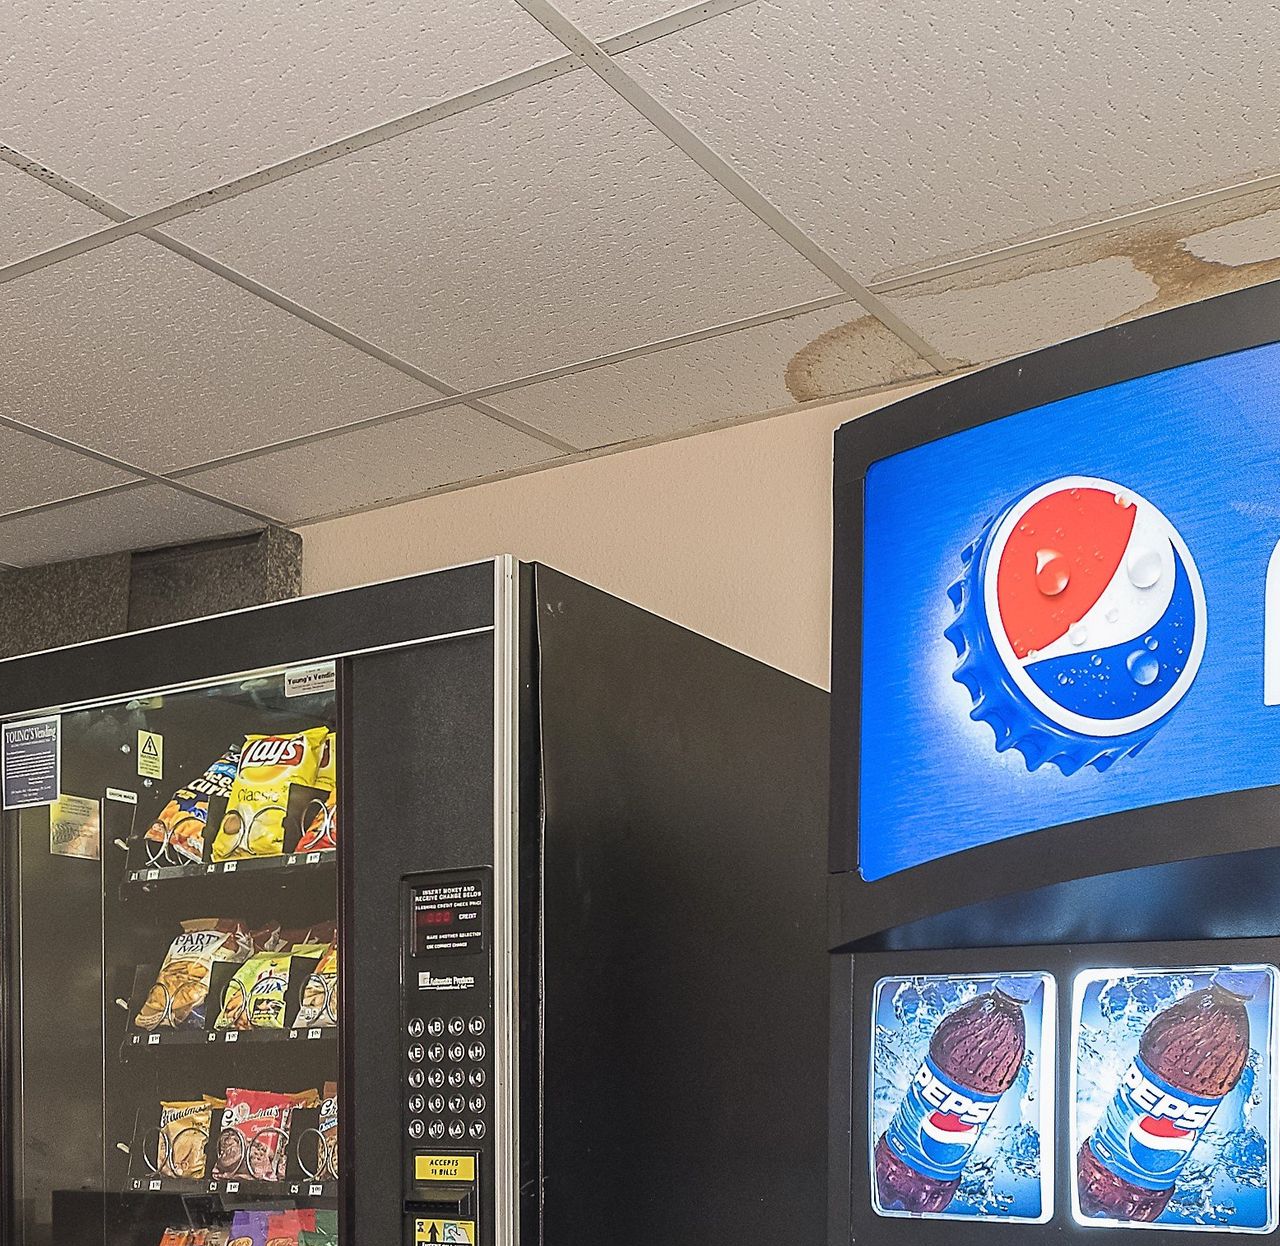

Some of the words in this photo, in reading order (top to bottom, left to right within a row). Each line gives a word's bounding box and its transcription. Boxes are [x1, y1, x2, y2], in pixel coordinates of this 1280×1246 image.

[314, 671, 335, 681] Vendin
[34, 724, 57, 742] Vending
[237, 788, 280, 803] Classic
[422, 888, 442, 896] INSERT
[439, 893, 462, 901] CHANGE
[458, 912, 477, 920] CREDIT
[414, 1022, 422, 1032] A
[434, 1021, 441, 1031] B
[454, 1021, 462, 1031] C
[475, 1020, 482, 1030] D
[414, 1047, 422, 1058] E
[434, 1047, 442, 1058] F
[454, 1047, 462, 1057] G
[475, 1046, 482, 1057] H
[414, 1073, 422, 1083] 1
[434, 1073, 442, 1083] 2
[454, 1073, 462, 1083] 3
[474, 1073, 483, 1083] 4
[913, 1060, 998, 1125] PEPS
[414, 1098, 422, 1108] 5
[434, 1098, 442, 1108] 6
[454, 1098, 462, 1108] 7
[474, 1098, 483, 1108] 8
[414, 1123, 422, 1133] 9
[432, 1123, 443, 1133] 10
[429, 1159, 459, 1167] ACCEPTS
[438, 1168, 458, 1176] BILLS
